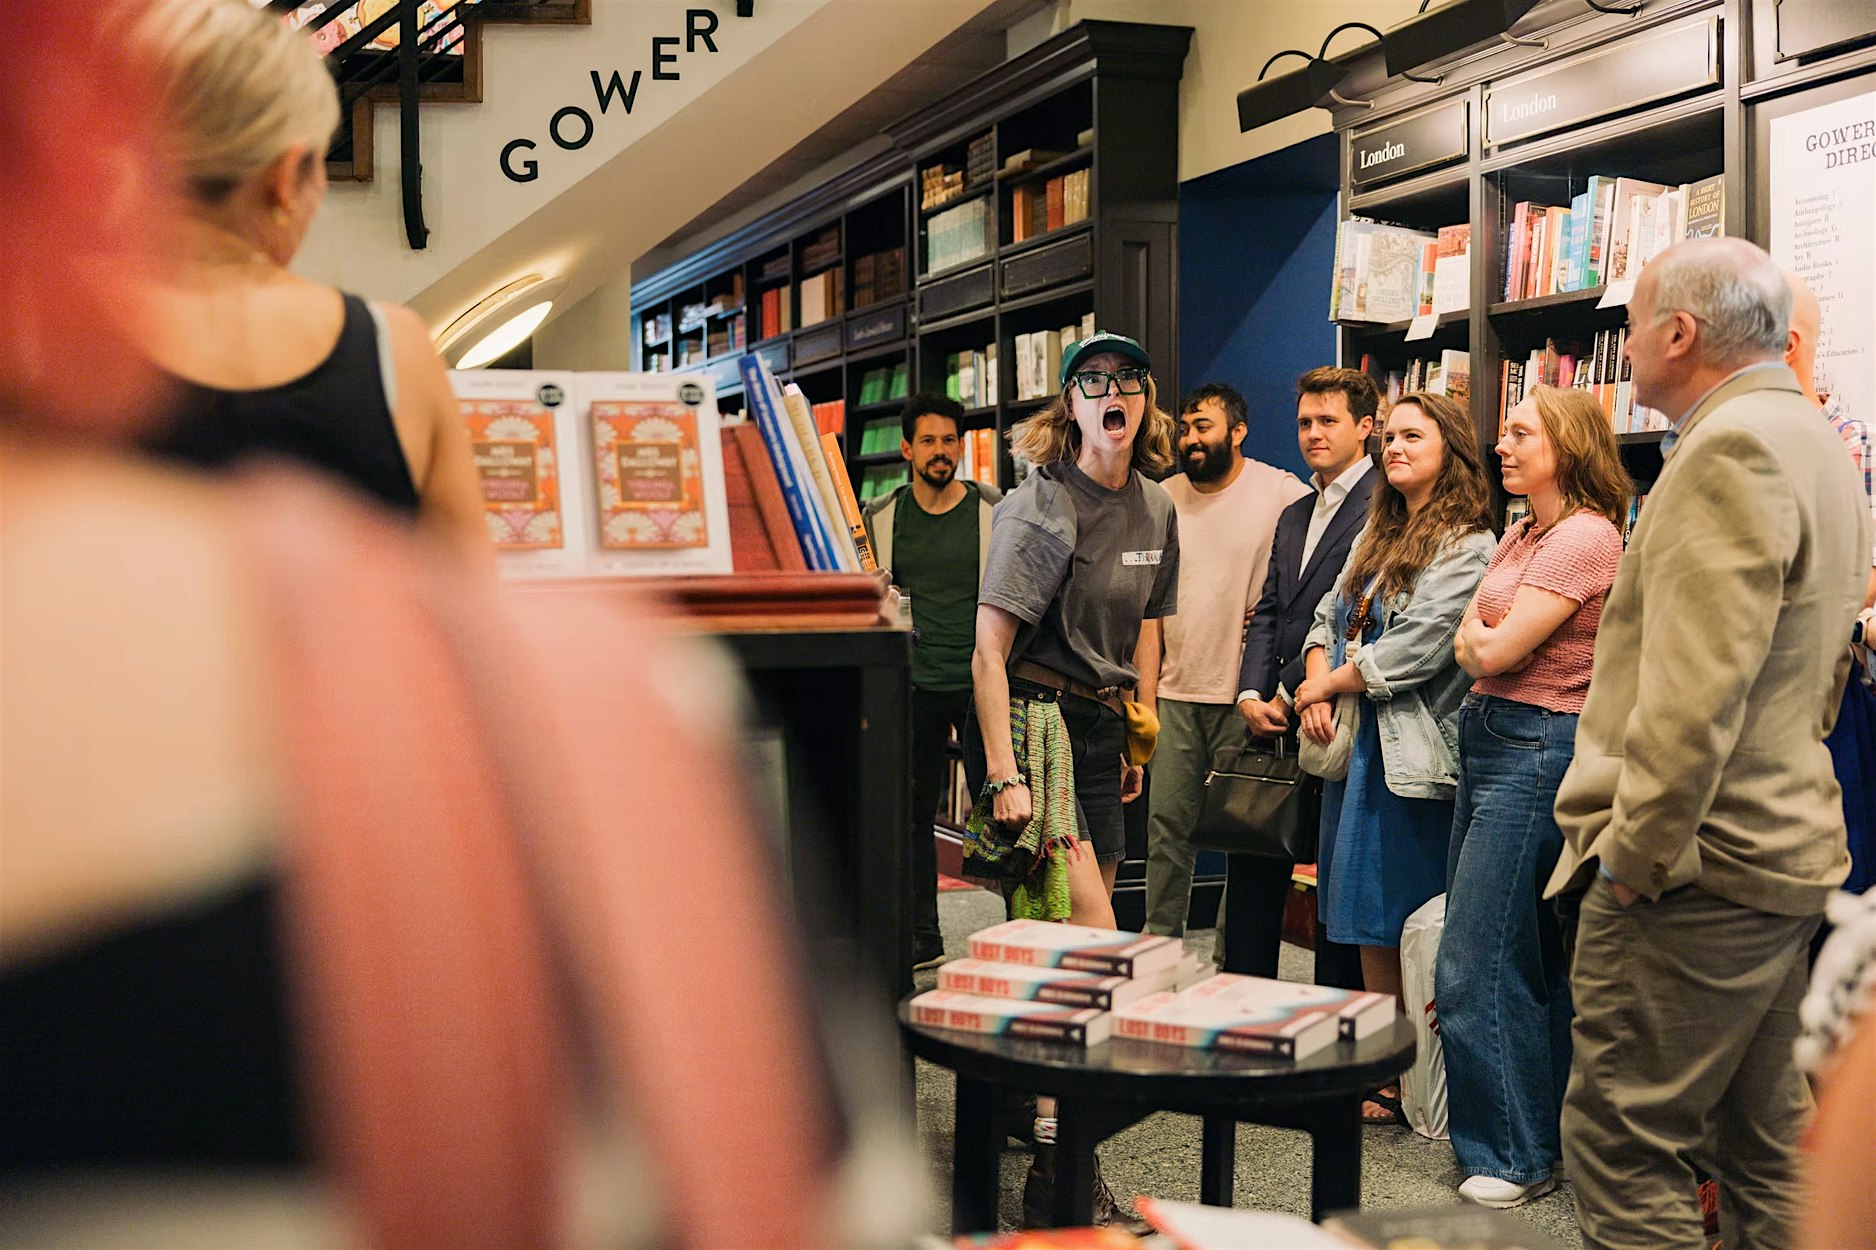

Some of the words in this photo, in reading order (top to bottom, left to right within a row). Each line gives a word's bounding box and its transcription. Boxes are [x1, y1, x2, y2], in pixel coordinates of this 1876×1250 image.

[500, 9, 719, 182] GOWER
[1502, 92, 1557, 123] London
[1806, 120, 1876, 152] GOWER
[1360, 140, 1405, 170] London
[1689, 200, 1719, 218] LONDON
[1794, 218, 1822, 228] Antiques
[1794, 238, 1832, 250] Architecture
[1794, 253, 1804, 261] Art
[1794, 262, 1812, 272] Audio
[1812, 260, 1832, 270] Books
[1826, 347, 1858, 358] Education
[971, 941, 1000, 959] LOST
[1004, 945, 1034, 963] BOYS
[945, 972, 975, 990] LOST
[978, 976, 1010, 995] BOYS
[916, 1006, 945, 1024] LOST
[951, 1011, 981, 1029] BOYS
[1118, 1018, 1149, 1036] LOST
[1153, 1024, 1187, 1042] BOYS
